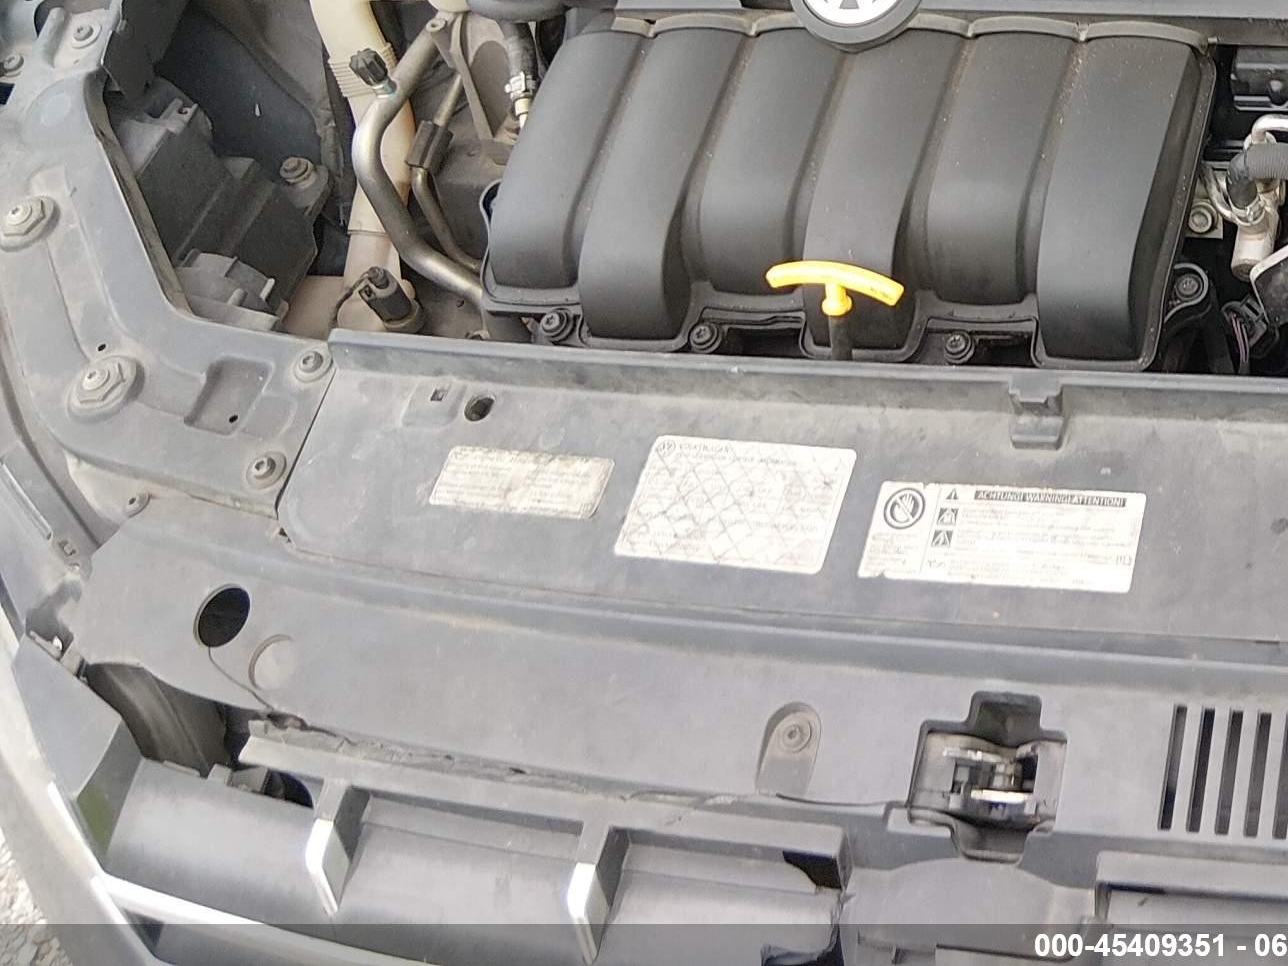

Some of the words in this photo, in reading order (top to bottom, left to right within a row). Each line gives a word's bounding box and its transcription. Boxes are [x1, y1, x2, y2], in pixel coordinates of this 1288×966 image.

[977, 490, 1023, 501] ACHTUNG!
[1025, 492, 1069, 504] WARNING!
[1072, 494, 1123, 507] ATTENTION!
